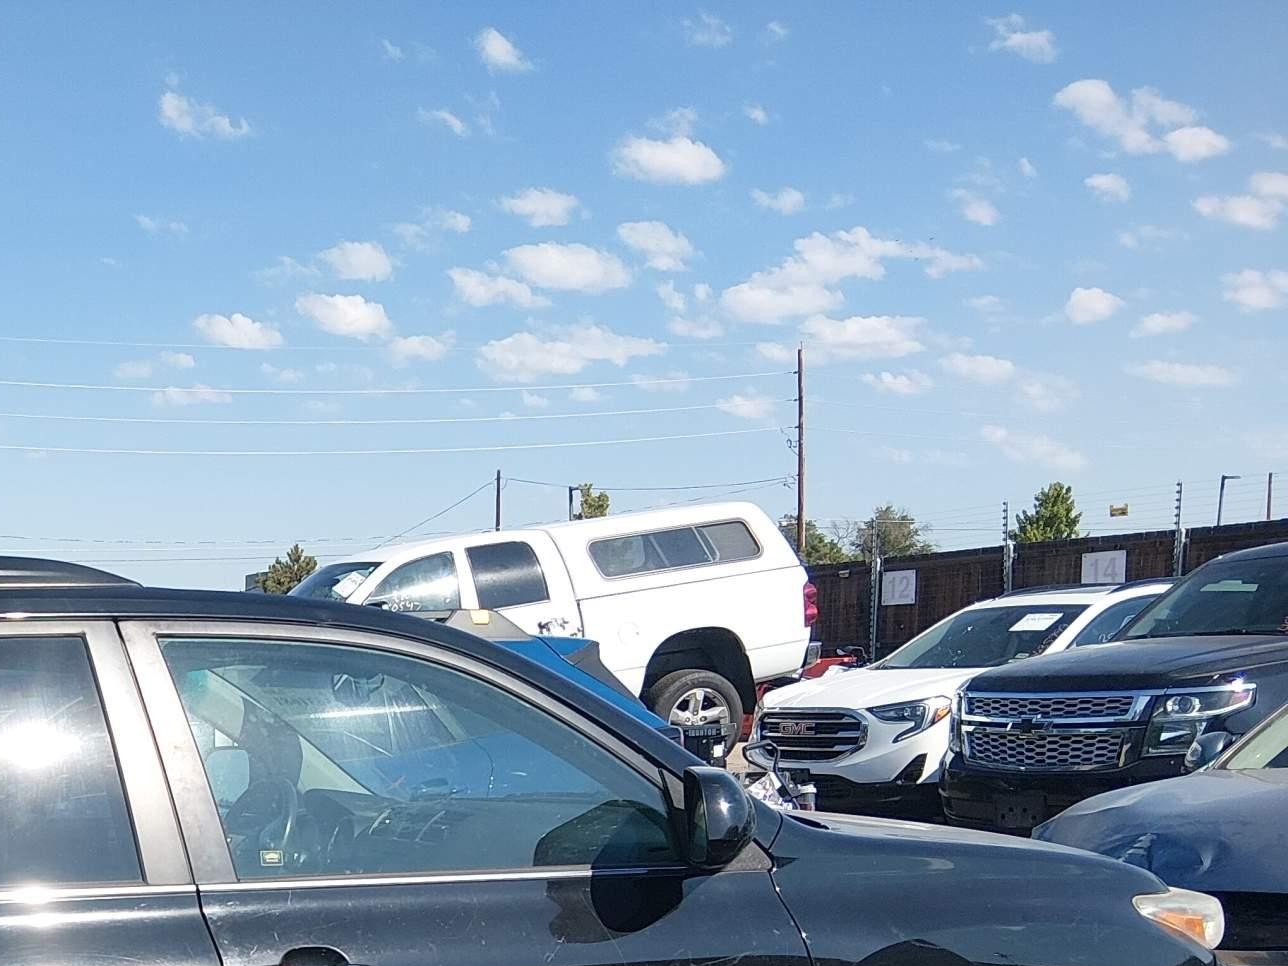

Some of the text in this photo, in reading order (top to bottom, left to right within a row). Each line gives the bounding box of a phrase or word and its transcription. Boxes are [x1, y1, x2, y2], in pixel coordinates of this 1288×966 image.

[1090, 557, 1119, 583] 14
[887, 576, 911, 599] 12
[779, 722, 816, 735] GMC
